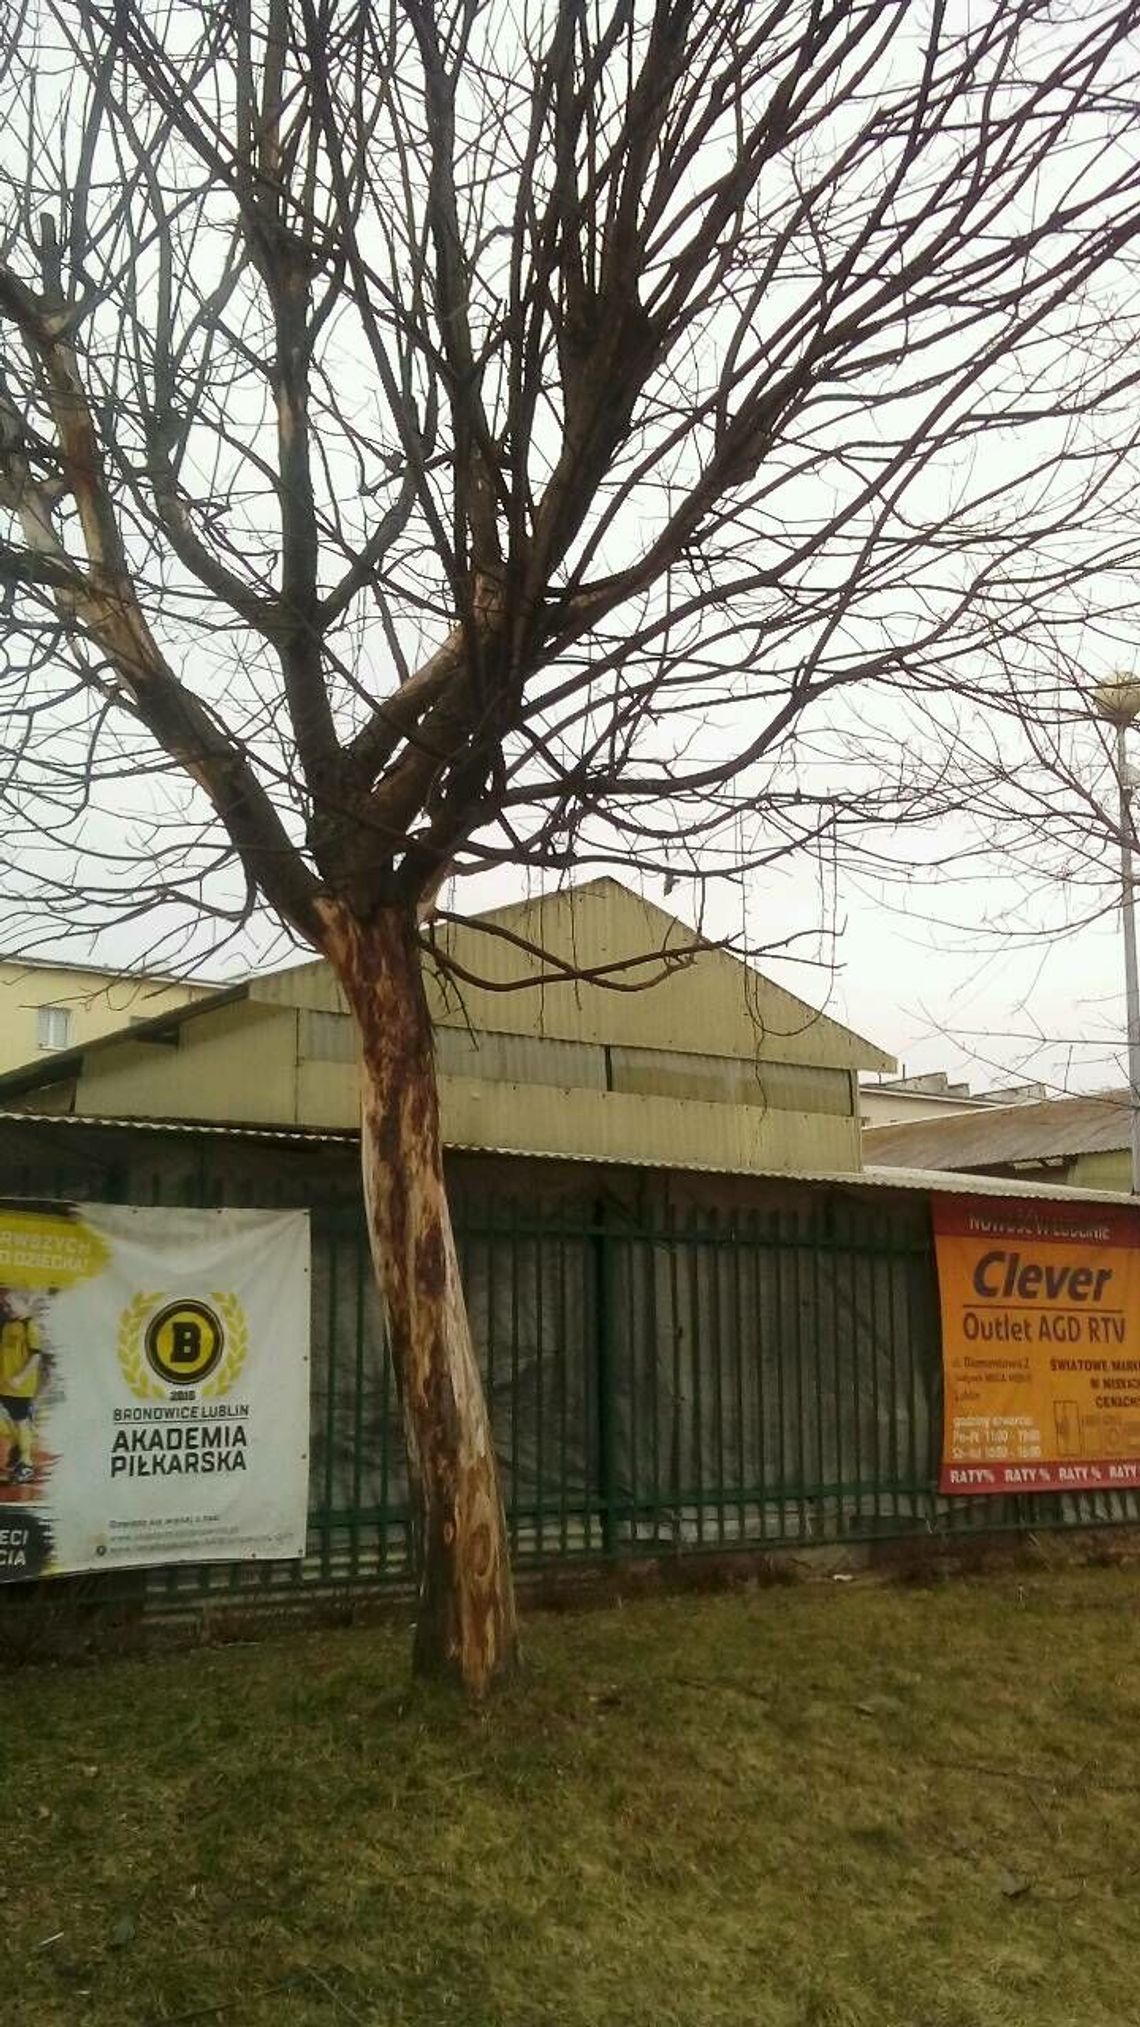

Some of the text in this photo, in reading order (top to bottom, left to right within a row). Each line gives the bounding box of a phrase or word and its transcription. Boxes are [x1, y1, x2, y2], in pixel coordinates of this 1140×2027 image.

[973, 1251, 1113, 1302] Clever
[963, 1312, 1126, 1344] Outlet AGD RTV
[170, 1322, 202, 1363] B
[113, 1404, 249, 1421] BRONOWICE LUBLIN
[111, 1425, 247, 1453] AKADEMIA
[110, 1450, 247, 1478] PIŁKARSKA
[1004, 1468, 1036, 1483] RATY
[1058, 1467, 1088, 1481] RATY
[1109, 1464, 1137, 1478] RATY
[0, 1529, 29, 1545] ECI
